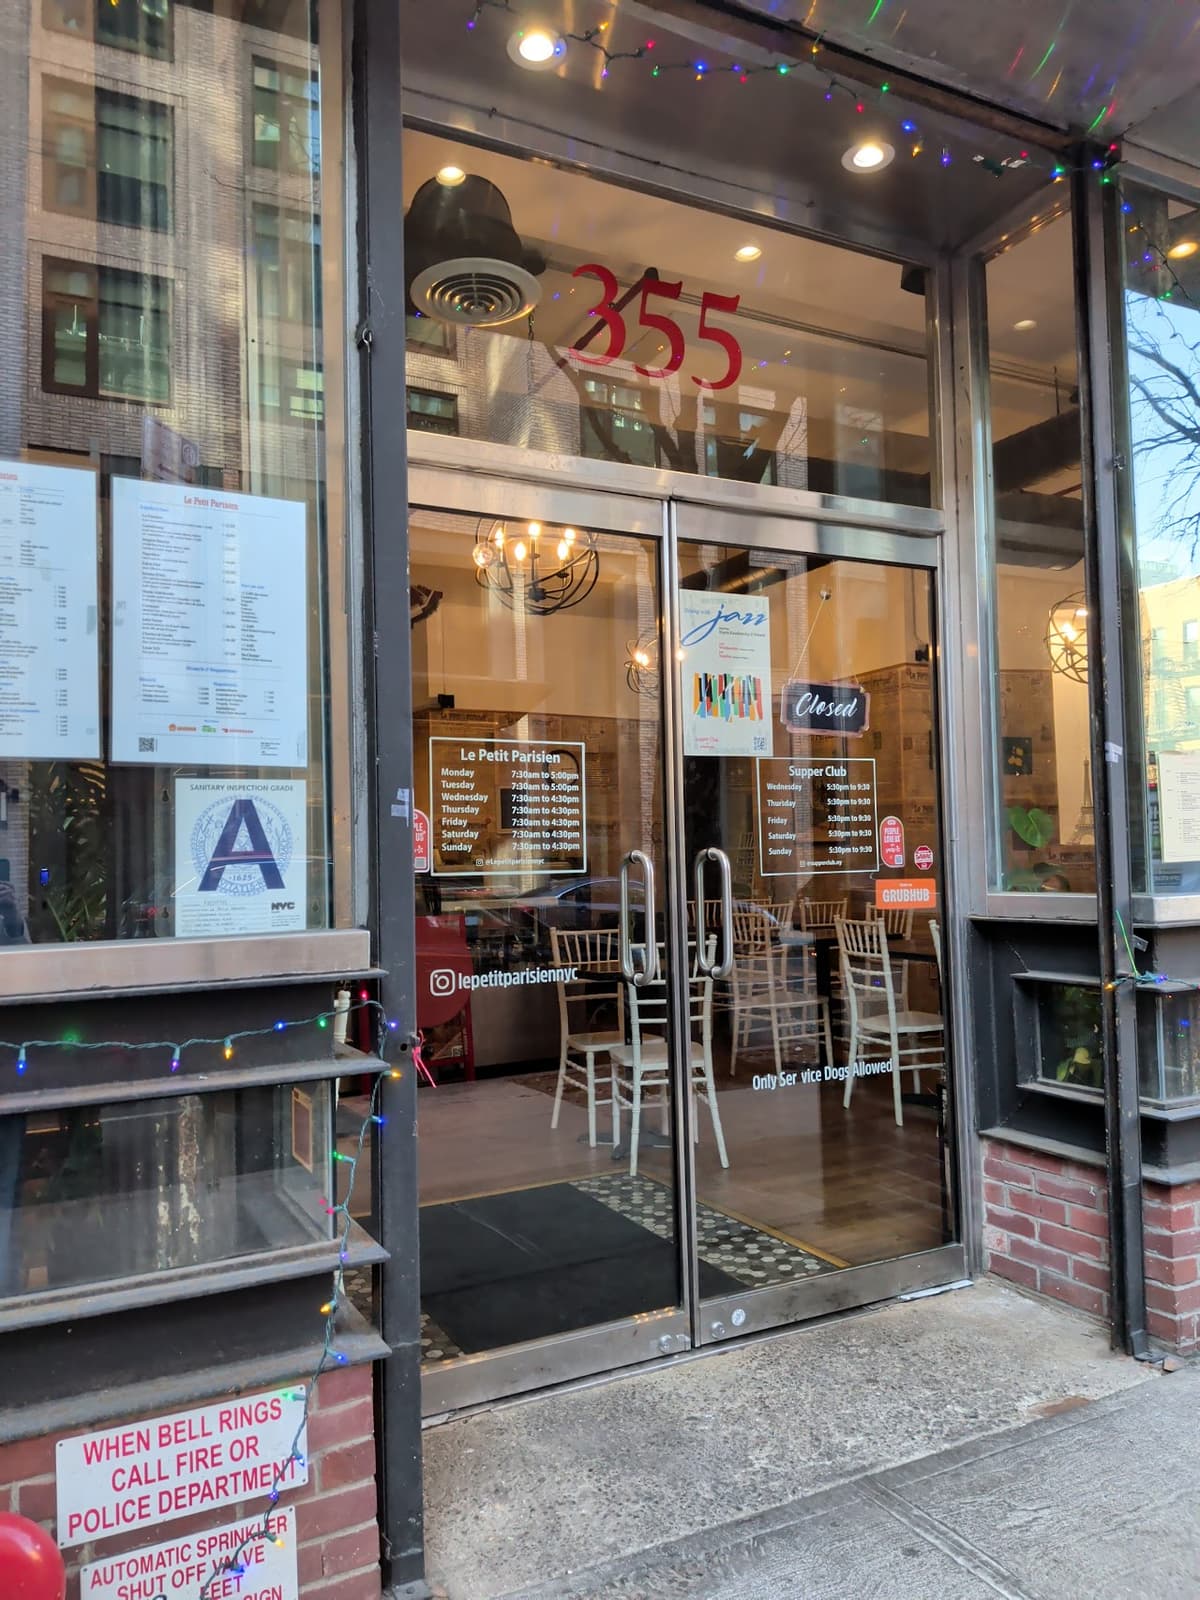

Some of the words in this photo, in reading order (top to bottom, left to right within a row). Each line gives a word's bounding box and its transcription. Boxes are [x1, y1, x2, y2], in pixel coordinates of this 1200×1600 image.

[568, 264, 742, 390] 355
[681, 602, 768, 647] jazz
[796, 692, 858, 718] Closed
[460, 748, 475, 762] Le
[478, 748, 509, 763] Petit
[511, 749, 561, 764] Parisien
[441, 768, 475, 779] Monday
[511, 771, 540, 780] 7:30am
[541, 772, 550, 780] to
[550, 772, 579, 781] 5:00pm
[789, 765, 823, 780] Supper
[825, 766, 847, 777] Club
[226, 784, 269, 792] INSPECTION
[270, 784, 293, 792] GRADE
[441, 780, 475, 791] Tuesday
[511, 783, 540, 792] 7:30am
[541, 784, 550, 792] to
[550, 784, 579, 793] 5:00pm
[766, 783, 802, 792] Wednesday
[441, 793, 488, 804] Wednesday
[511, 794, 540, 803] 7:30am
[541, 795, 550, 803] to
[550, 795, 579, 804] 4:30pm
[767, 799, 796, 808] Thursday
[850, 798, 857, 806] to
[858, 798, 871, 806] 9:30
[441, 805, 479, 816] Thursday
[511, 806, 540, 815] 7:30am
[541, 807, 550, 815] to
[550, 807, 579, 816] 4:30pm
[441, 817, 468, 828] Friday
[511, 818, 540, 827] 7:30am
[541, 819, 550, 827] to
[550, 819, 579, 828] 4:30pm
[768, 816, 788, 825] Friday
[441, 830, 479, 840] Saturday
[511, 830, 540, 839] 7:30am
[541, 831, 550, 839] to
[550, 831, 579, 840] 4:30pm
[768, 832, 796, 841] Saturday
[198, 799, 285, 891] A
[441, 842, 473, 853] Sunday
[511, 842, 540, 851] 7:30am
[541, 843, 550, 851] to
[550, 843, 579, 852] 4:30pm
[768, 847, 793, 856] Sunday
[882, 888, 930, 903] GRUBHUB
[271, 902, 295, 911] NYC
[458, 967, 578, 990] lepetitparisiennyc
[752, 1073, 777, 1090] Only
[824, 1065, 849, 1081] Dogs
[852, 1058, 893, 1077] Allowed
[83, 1429, 150, 1465] WHEN
[158, 1415, 212, 1448] BELL
[219, 1398, 282, 1433] RINGS
[111, 1459, 169, 1492] CALL
[176, 1447, 223, 1476] FIRE
[230, 1436, 259, 1462] OR
[68, 1496, 151, 1538] POLICE
[158, 1458, 297, 1514] DEPARTMENT
[90, 1543, 192, 1590] AUTOMATIC
[196, 1515, 287, 1558] SPRINKLER
[117, 1576, 165, 1600] SHUT
[171, 1563, 206, 1589] OFF
[212, 1545, 265, 1576] VAVE
